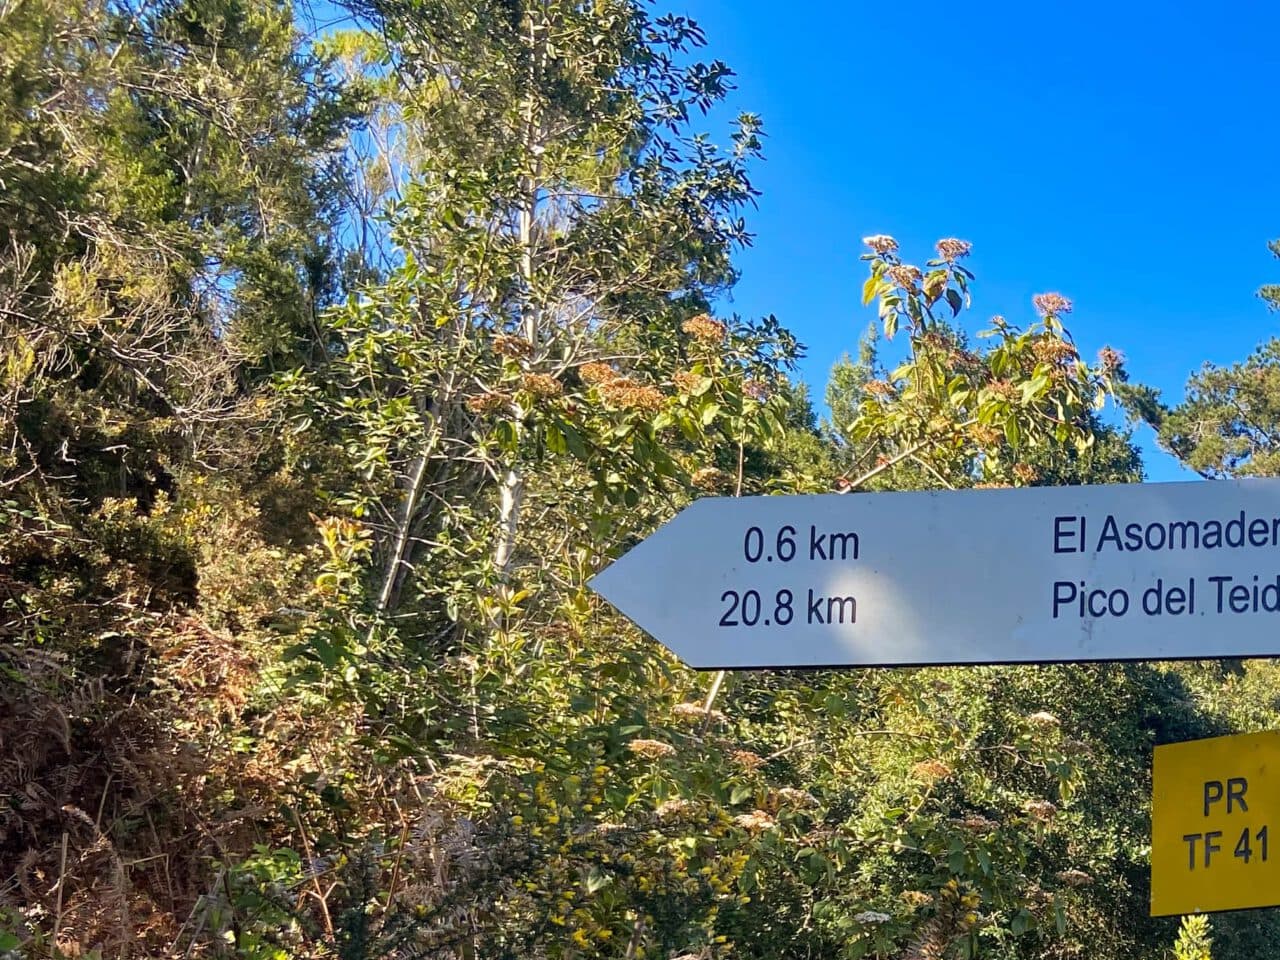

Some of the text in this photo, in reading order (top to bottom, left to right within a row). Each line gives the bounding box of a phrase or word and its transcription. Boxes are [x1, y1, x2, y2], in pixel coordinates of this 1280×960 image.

[744, 524, 860, 564] 0.6 km
[1053, 515, 1086, 554] El
[718, 588, 857, 627] 20.8 km
[1052, 580, 1130, 619] Pico
[1142, 577, 1195, 617] del
[1203, 777, 1249, 817] PR
[1182, 825, 1268, 871] TF 41
